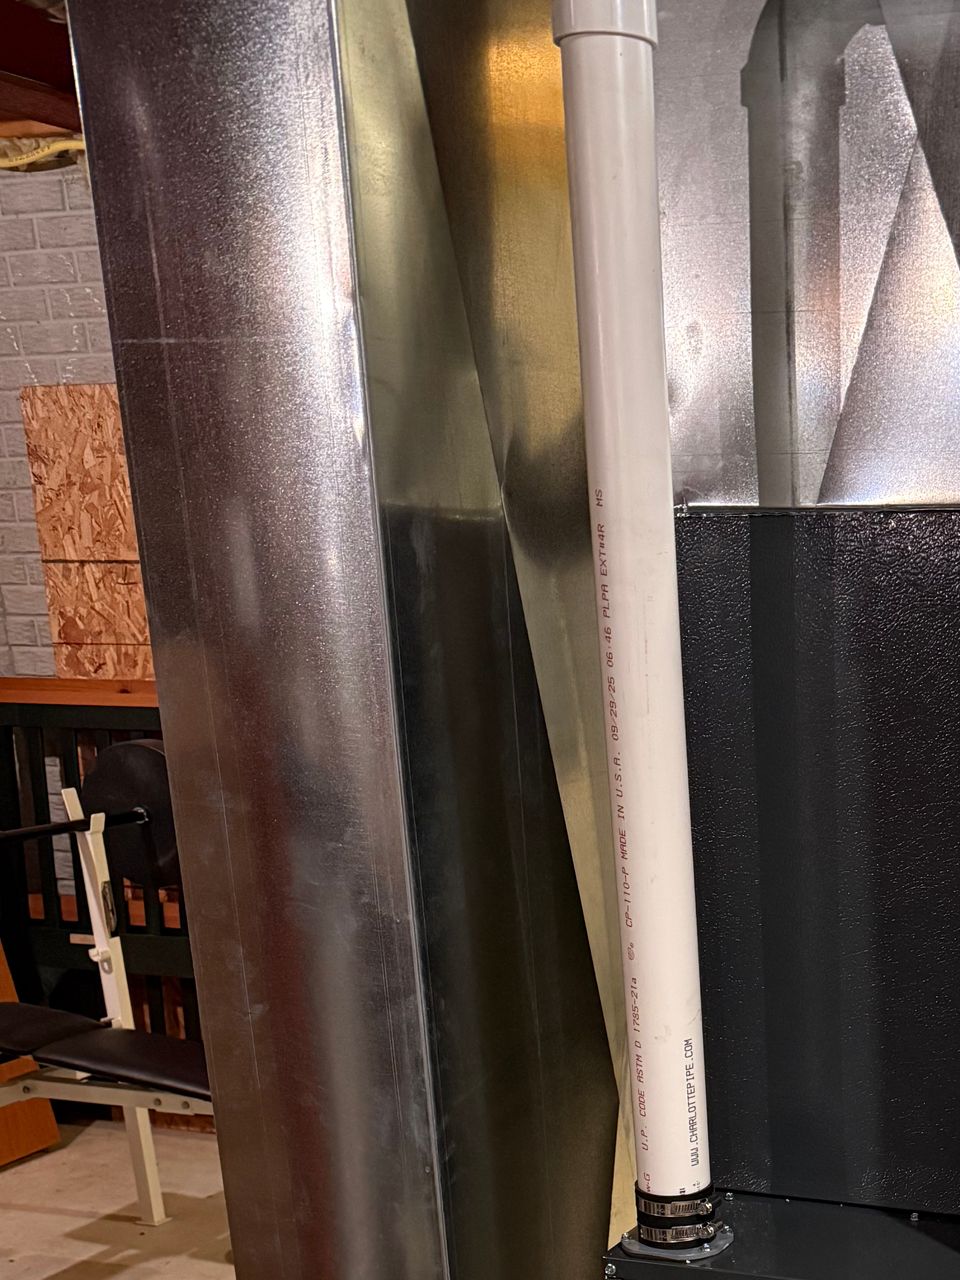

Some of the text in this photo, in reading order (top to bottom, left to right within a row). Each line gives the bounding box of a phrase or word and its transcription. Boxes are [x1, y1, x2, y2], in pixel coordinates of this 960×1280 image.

[594, 489, 603, 507] MS
[607, 676, 619, 741] 09/29/25
[613, 750, 623, 798] U.S.A.
[616, 805, 625, 820] IN
[618, 828, 628, 860] MADE
[621, 866, 633, 928] CP-110-P
[634, 1039, 642, 1049] D
[634, 1054, 644, 1083] ASTM
[637, 1090, 647, 1117] CODE
[684, 1038, 700, 1167] WWW.CHARLOTTEPIPE.COM
[640, 1125, 649, 1150] U.P.
